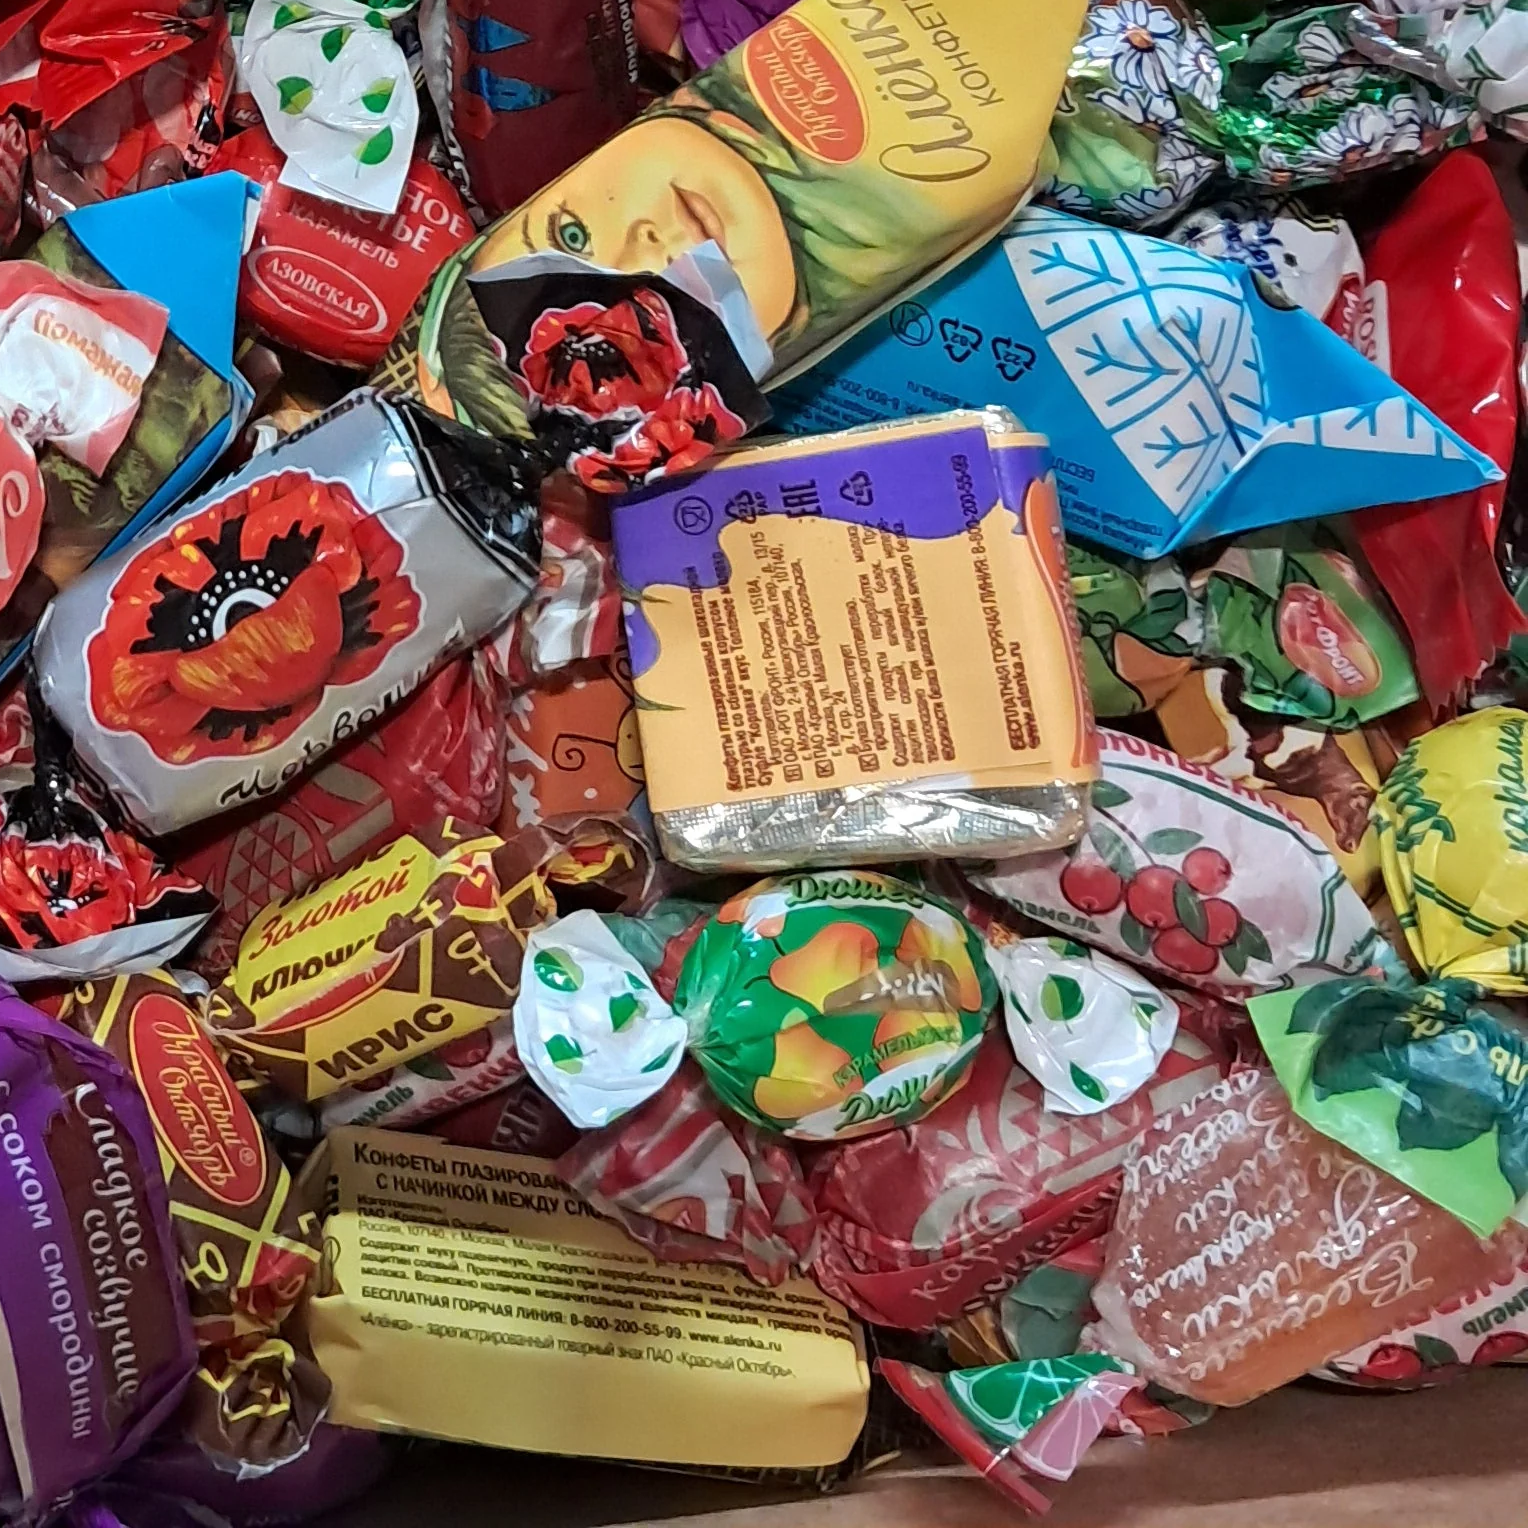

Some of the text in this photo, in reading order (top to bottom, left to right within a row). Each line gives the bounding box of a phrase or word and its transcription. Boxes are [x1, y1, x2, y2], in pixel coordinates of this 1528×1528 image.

[290, 200, 401, 269] КАРАМЕЛЬ
[265, 254, 371, 321] АЗОВСКАЯ
[247, 859, 420, 960] Золотой
[166, 1009, 248, 1152] Красный
[314, 1002, 456, 1083] ИРИС
[161, 1066, 231, 1189] Октябрь
[351, 1141, 449, 1177] КОНФЕТЫ
[75, 1081, 147, 1269] Сладкое
[391, 1173, 487, 1205] НАЧИНКОЙ
[490, 1186, 562, 1216] МЕЖДУ
[33, 1240, 92, 1439] смородины
[85, 1206, 140, 1397] созвучие
[360, 1285, 449, 1310] БЕСПЛАТНАЯ
[451, 1296, 513, 1318] ГОРЯЧАЯ
